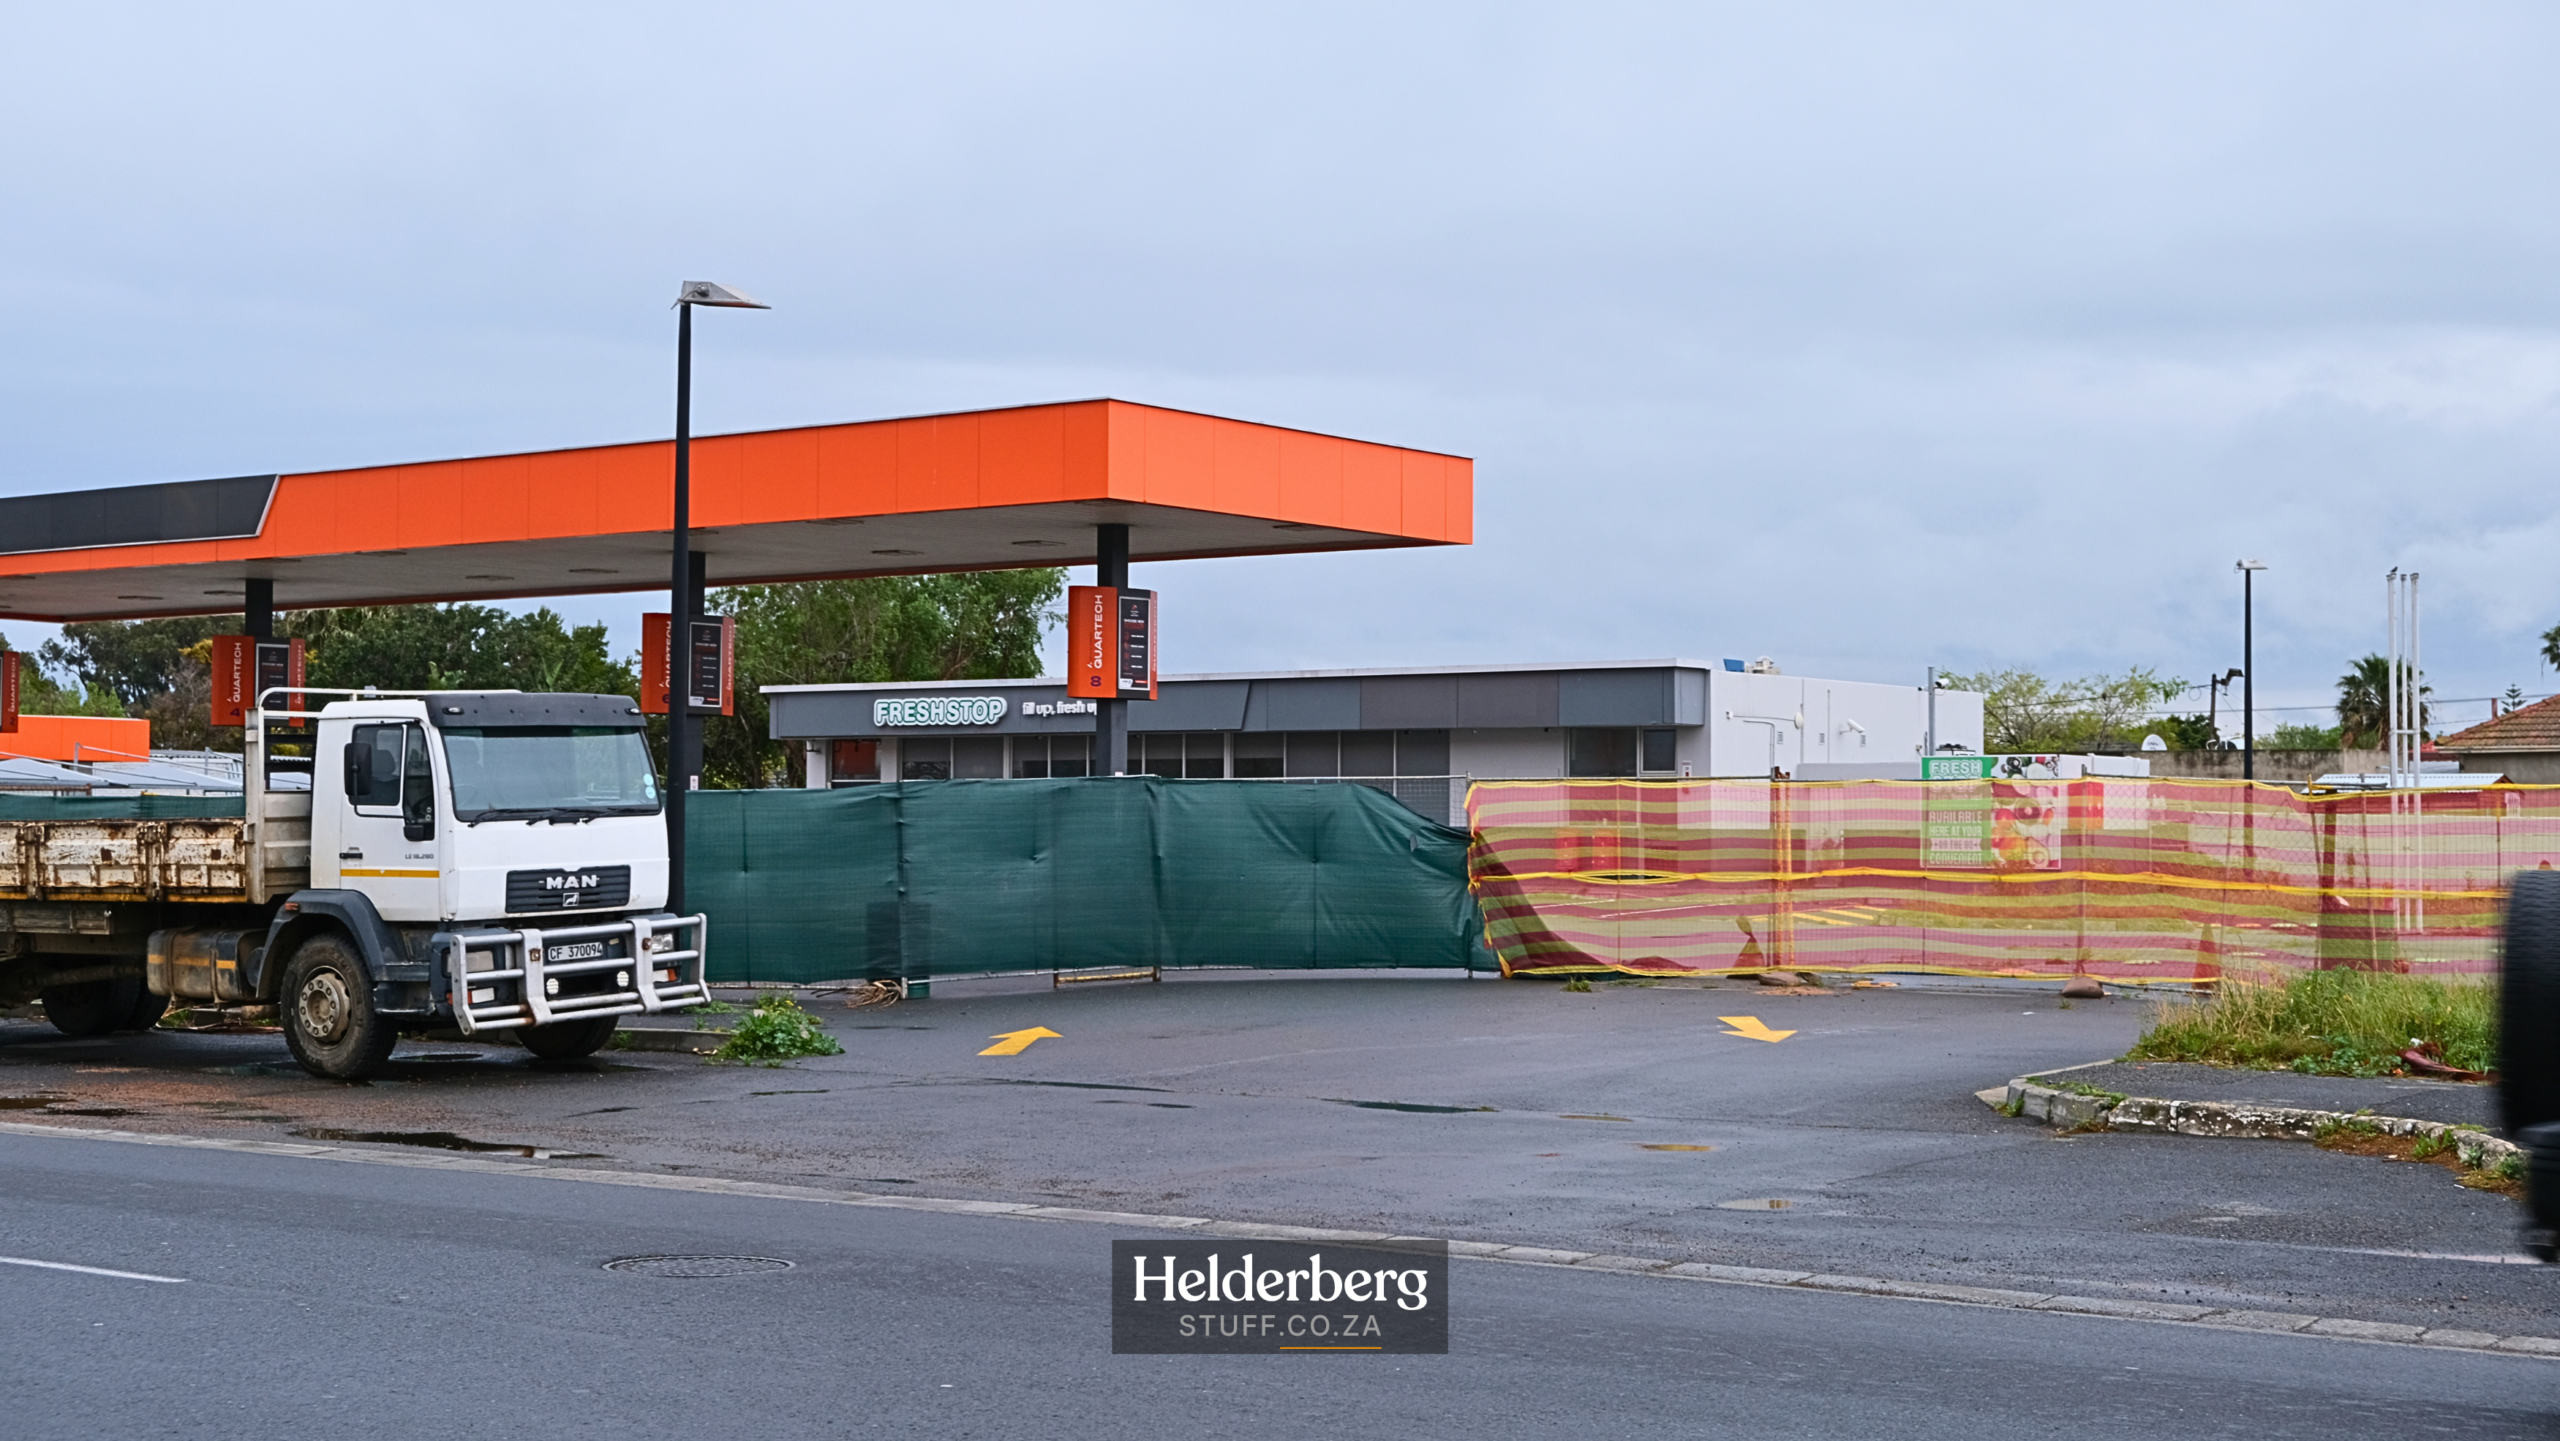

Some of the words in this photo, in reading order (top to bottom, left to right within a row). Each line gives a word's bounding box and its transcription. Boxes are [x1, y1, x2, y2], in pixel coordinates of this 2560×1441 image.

[1094, 595, 1103, 669] QUARTECH
[233, 643, 242, 703] QUARTECH
[1090, 676, 1102, 687] 8
[230, 706, 240, 716] 4
[874, 697, 1007, 726] FRESHSTOP
[1022, 702, 1035, 715] fill
[1036, 704, 1056, 717] up,
[1056, 701, 1086, 714] fresh
[1930, 761, 1981, 775] FRESH
[1930, 811, 1982, 823] AVAILABLE
[1930, 826, 1949, 836] HERE
[1951, 826, 1960, 836] AT
[1962, 826, 1982, 836] YOUR
[1950, 840, 1962, 849] THE
[1930, 852, 1982, 864] CONVENIENT
[546, 875, 597, 889] MAN
[550, 947, 562, 960] CF
[568, 943, 602, 958] 370094
